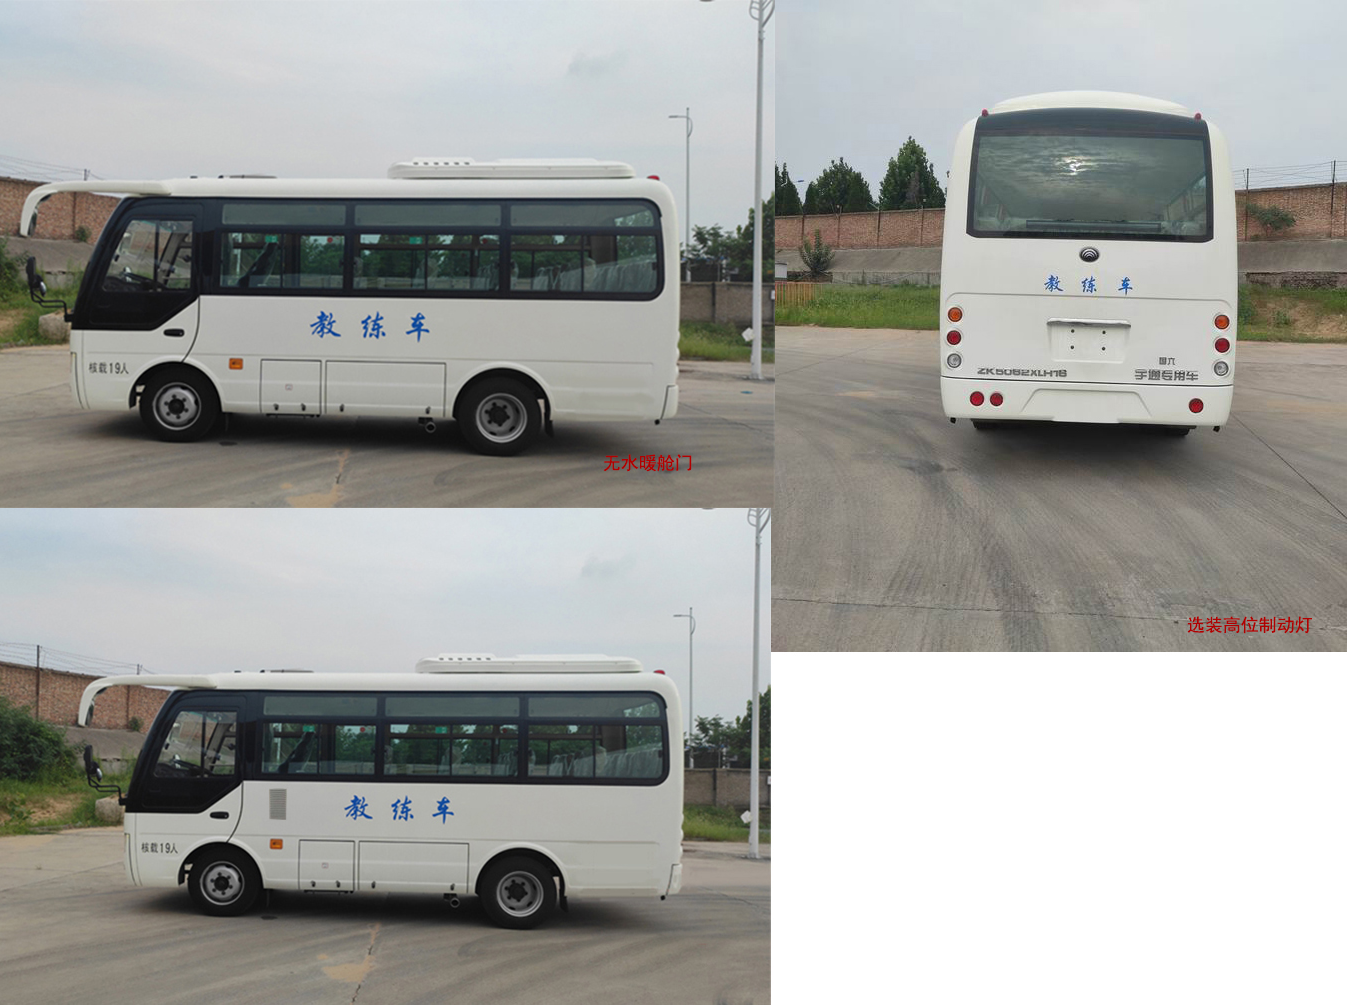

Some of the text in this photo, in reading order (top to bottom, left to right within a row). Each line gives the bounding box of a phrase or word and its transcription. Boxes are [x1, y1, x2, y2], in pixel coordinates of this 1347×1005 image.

[1046, 274, 1131, 294] 教练车
[310, 310, 430, 342] 教练车
[88, 362, 129, 374] 核载19人
[344, 795, 455, 825] 教练车
[141, 842, 178, 854] 核载19人
